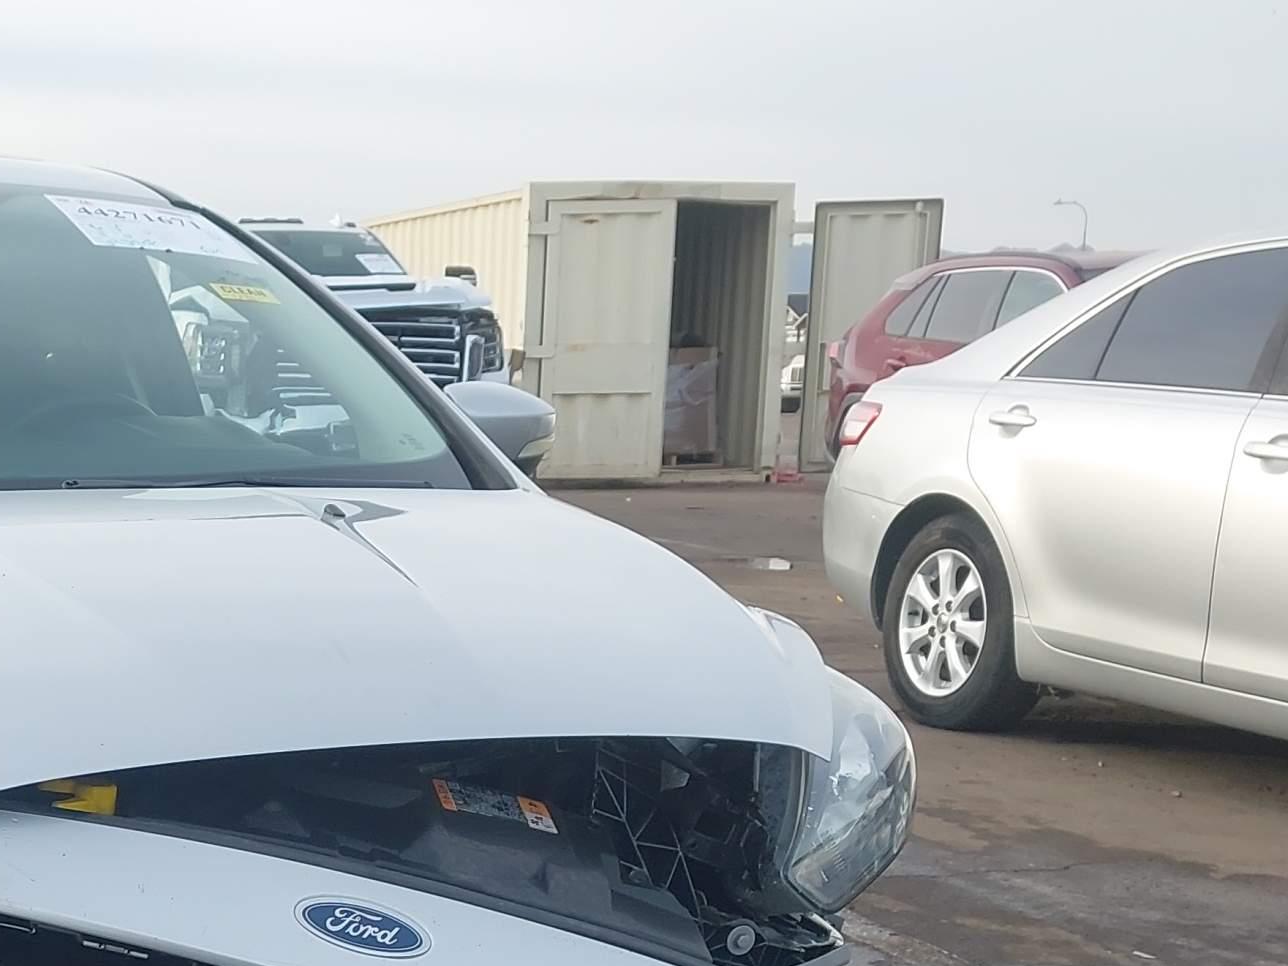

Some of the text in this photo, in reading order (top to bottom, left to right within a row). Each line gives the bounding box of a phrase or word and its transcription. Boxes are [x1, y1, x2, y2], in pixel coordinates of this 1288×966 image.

[77, 206, 201, 230] 44271671
[219, 285, 267, 298] CLEAN
[325, 907, 401, 945] Ford
